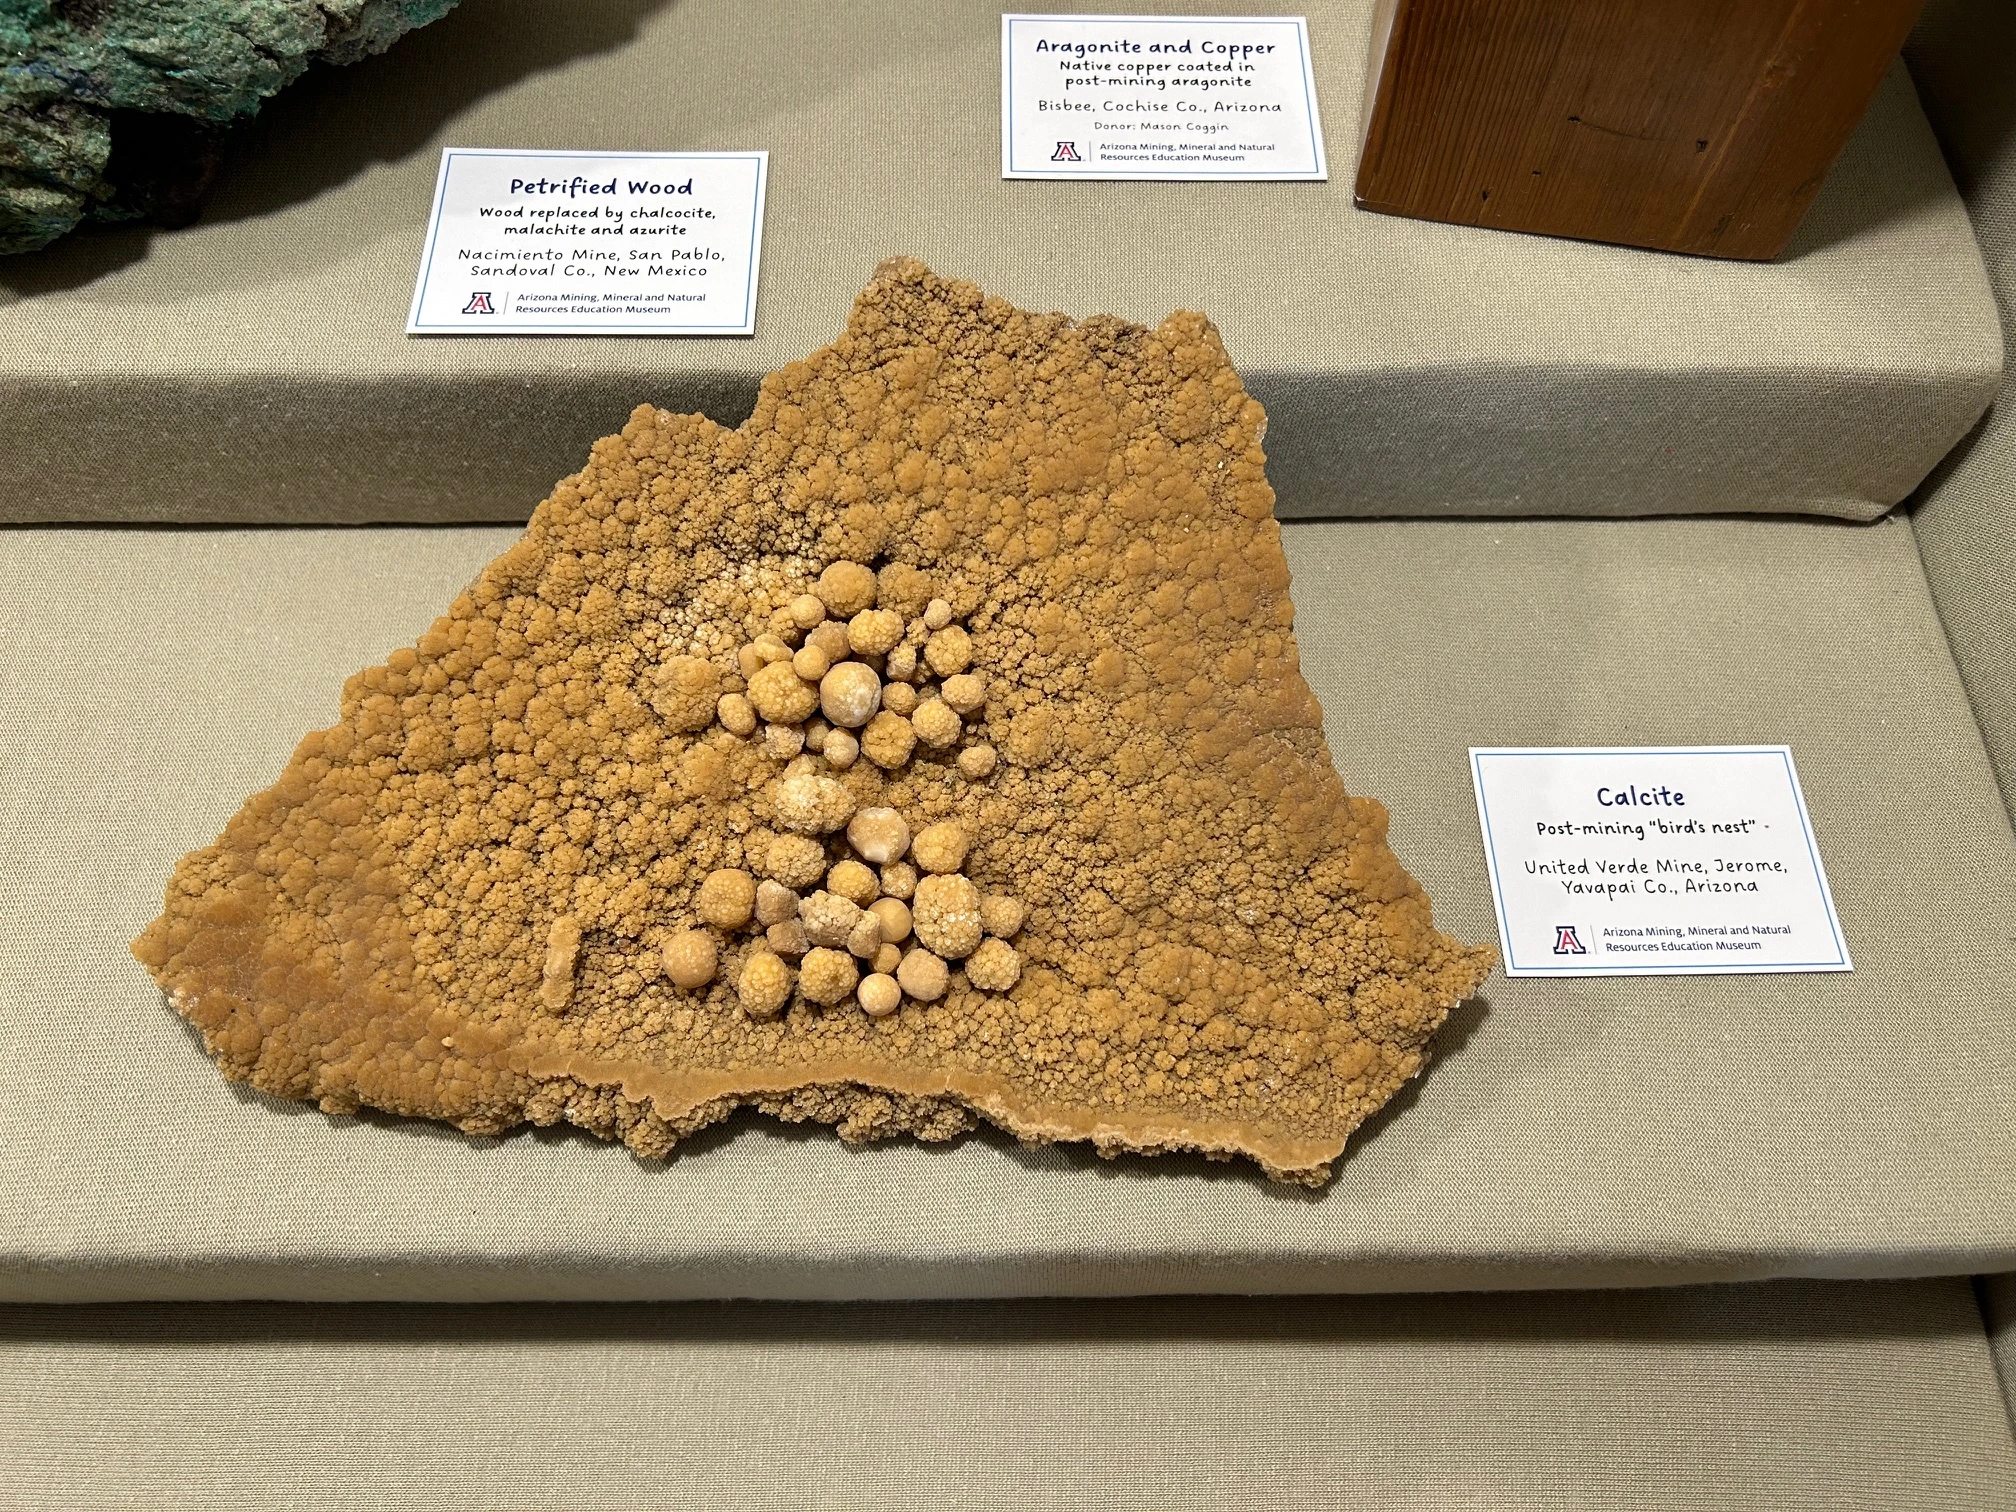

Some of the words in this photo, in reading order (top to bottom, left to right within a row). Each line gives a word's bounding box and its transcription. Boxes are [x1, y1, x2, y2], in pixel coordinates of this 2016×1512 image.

[1035, 38, 1142, 60] Aragonite
[1148, 38, 1193, 55] and
[1200, 40, 1276, 61] Copper
[1059, 59, 1112, 72] Native
[1117, 63, 1172, 77] copper
[1176, 60, 1234, 73] coated
[1238, 61, 1256, 73] in
[1065, 74, 1166, 91] post-mining
[1171, 75, 1252, 92] aragonite
[1038, 98, 1096, 113] Bisbee,
[1102, 99, 1169, 113] Cochise
[1175, 100, 1207, 114] Co.,
[1213, 100, 1282, 113] Arizona
[1093, 121, 1136, 131] Donor:
[1140, 122, 1182, 131] Mason
[1186, 122, 1230, 135] Coggin
[1050, 141, 1082, 162] A
[1099, 142, 1138, 151] Arizona
[1139, 142, 1177, 153] Mining,
[1178, 143, 1216, 151] Mineral
[1217, 143, 1237, 151] and
[1238, 143, 1275, 151] Natural
[1100, 153, 1150, 161] Resources
[1151, 153, 1201, 162] Education
[1202, 154, 1246, 162] Museum
[510, 175, 618, 200] Petrified
[627, 177, 693, 196] Wood
[479, 205, 524, 219] Wood
[529, 205, 600, 223] replaced
[604, 205, 624, 224] by
[629, 206, 716, 220] chalcocite,
[503, 222, 587, 236] malachite
[590, 223, 624, 236] and
[629, 223, 687, 236] azurite
[458, 248, 564, 261] Nacimiento
[571, 248, 621, 263] Mine,
[628, 249, 663, 261] San
[671, 246, 725, 263] Pablo,
[470, 262, 556, 277] Sandoval
[563, 264, 596, 278] Co.,
[604, 264, 640, 277] New
[647, 264, 708, 277] Mexico
[461, 291, 496, 315] A
[516, 293, 558, 302] Arizona
[559, 293, 600, 304] Mining,
[602, 293, 643, 302] Mineral
[644, 293, 665, 302] and
[667, 293, 707, 302] Natural
[515, 305, 569, 314] Resources
[570, 305, 623, 314] Education
[624, 305, 671, 314] Museum
[1596, 784, 1686, 807] Calcite
[1536, 820, 1645, 842] Post-mining
[1524, 857, 1591, 876] United
[1594, 857, 1649, 875] Verde
[1656, 858, 1709, 875] Mine,
[1713, 858, 1788, 874] Jerome,
[1560, 879, 1637, 902] Yavapai
[1643, 878, 1679, 896] Co.,
[1685, 877, 1759, 894] Arizona
[1552, 925, 1587, 956] A
[1602, 926, 1645, 937] Arizona
[1645, 925, 1686, 939] Mining,
[1687, 925, 1728, 936] Mineral
[1729, 924, 1750, 936] and
[1751, 924, 1792, 935] Natural
[1605, 942, 1660, 952] Resources
[1660, 940, 1714, 952] Education
[1715, 941, 1762, 951] Museum
